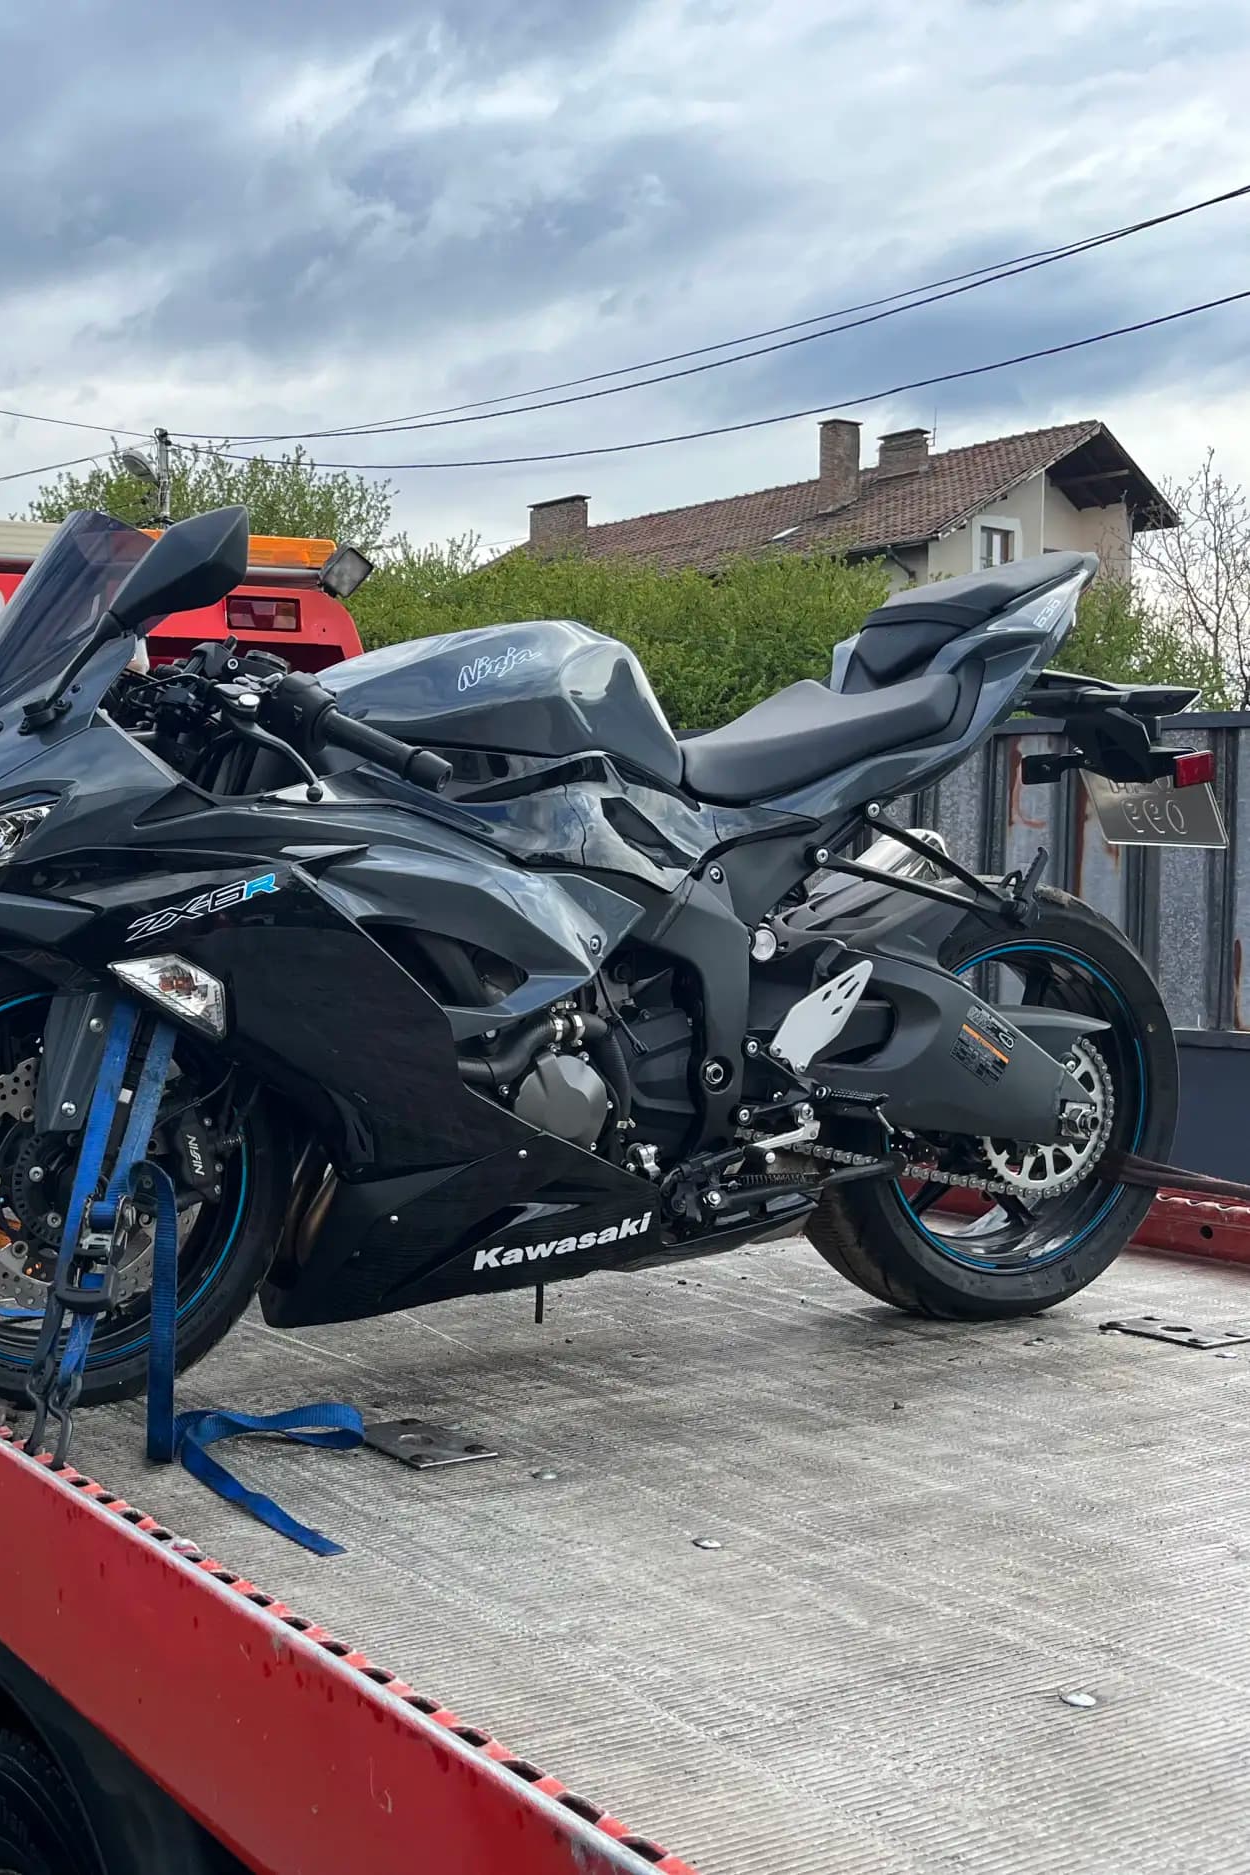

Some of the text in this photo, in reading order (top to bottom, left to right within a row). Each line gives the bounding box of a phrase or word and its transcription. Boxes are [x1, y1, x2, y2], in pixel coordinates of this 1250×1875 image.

[1032, 598, 1061, 628] 636
[458, 647, 542, 691] Ninja
[473, 1211, 652, 1271] Kawasaki
